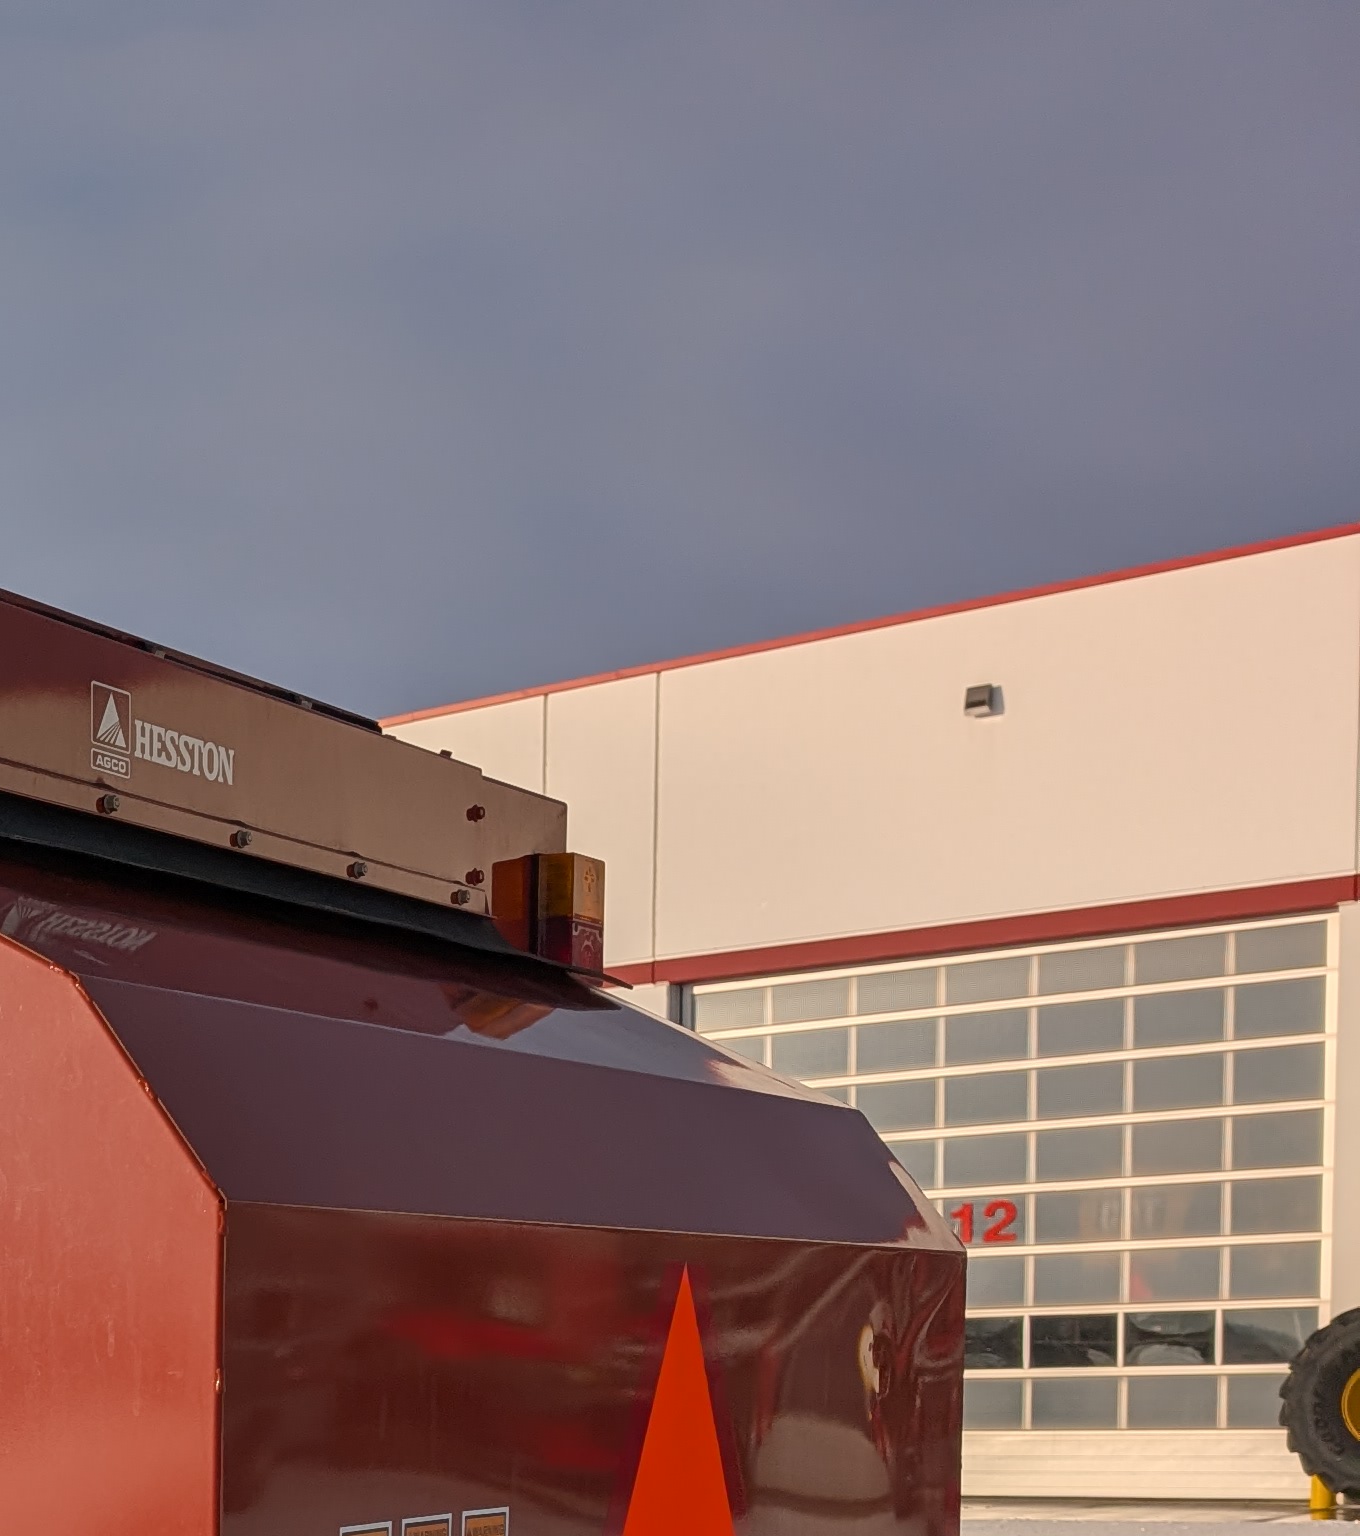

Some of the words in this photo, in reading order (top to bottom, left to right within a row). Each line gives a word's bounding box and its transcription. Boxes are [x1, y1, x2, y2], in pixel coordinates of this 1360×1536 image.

[96, 755, 126, 773] AGCO
[134, 719, 235, 786] HESSTON
[950, 1199, 1018, 1244] 12
